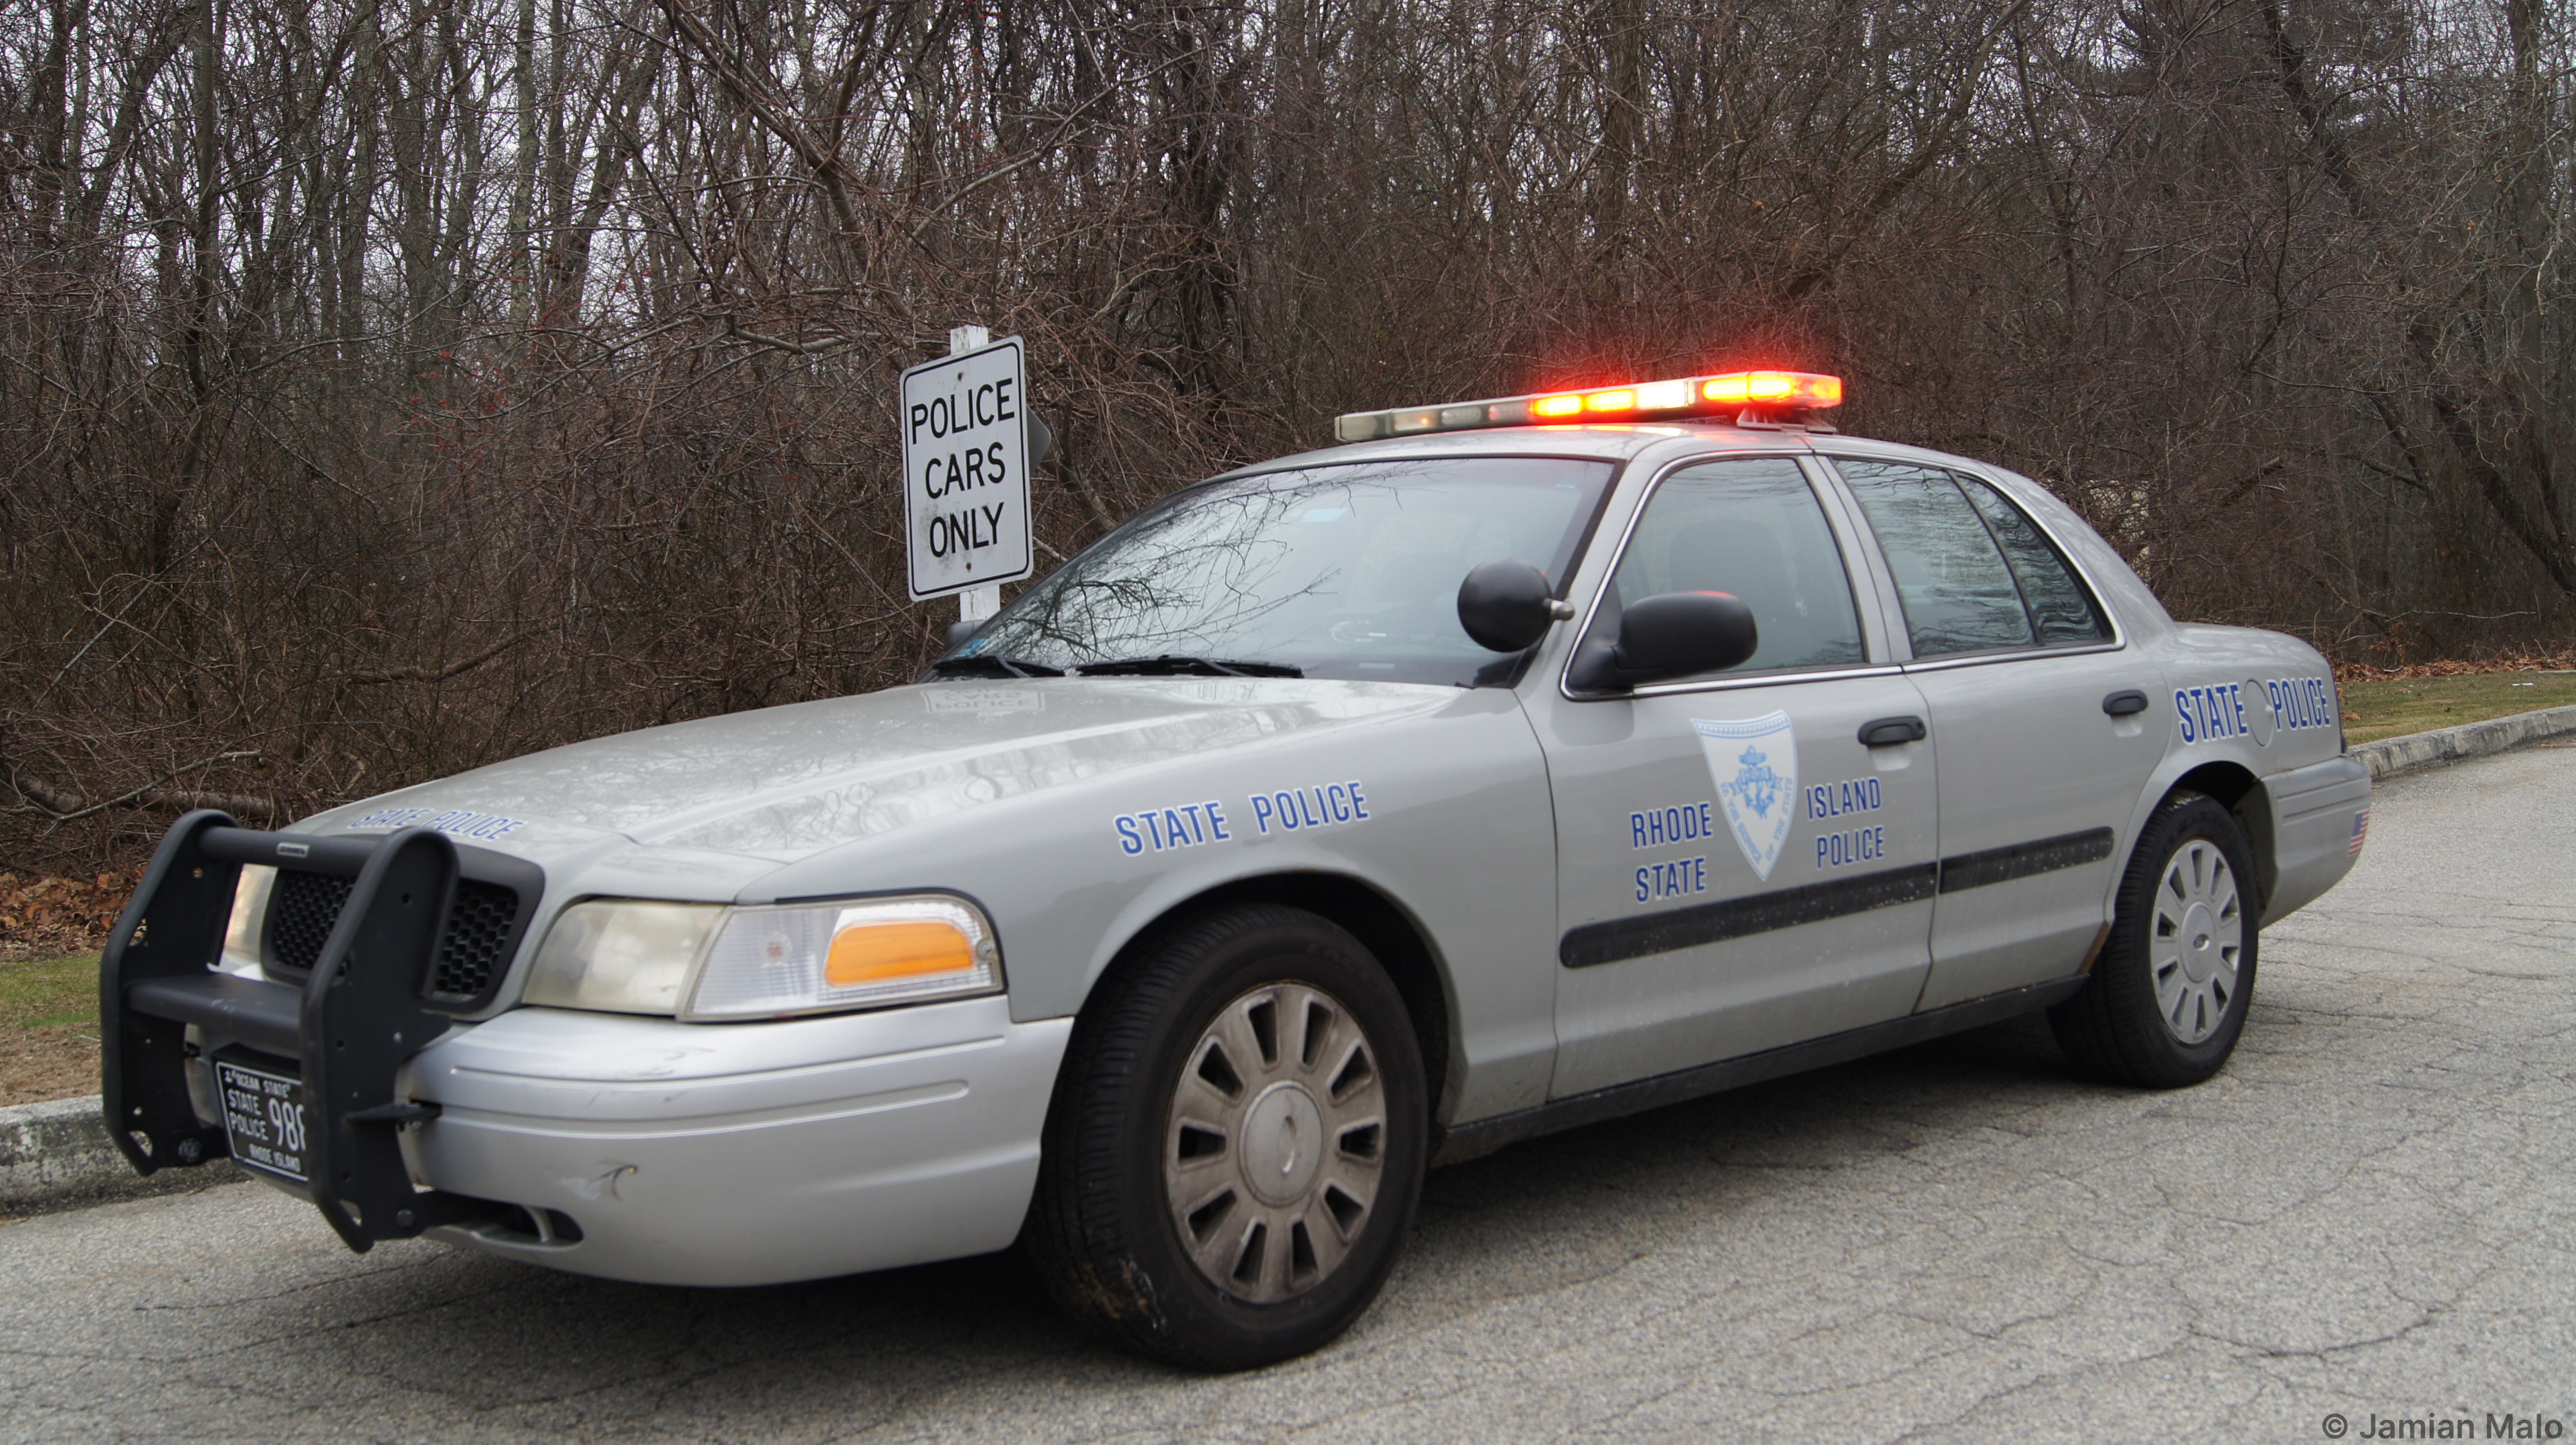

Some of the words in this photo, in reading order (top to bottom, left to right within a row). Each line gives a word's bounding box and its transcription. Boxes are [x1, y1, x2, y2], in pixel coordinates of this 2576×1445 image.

[912, 378, 1014, 444] POLICE
[925, 441, 1005, 499] CARS
[930, 502, 1004, 557] ONLY
[2175, 684, 2247, 744] STATE
[2267, 678, 2330, 731] POLICE
[349, 808, 432, 829] STATE
[422, 811, 526, 841] POLICE
[1115, 802, 1230, 855] STATE
[1250, 781, 1369, 834] POLICE
[1630, 802, 1713, 849] RHODE
[1805, 777, 1882, 820] ISLAND
[1636, 857, 1706, 903] STATE
[1817, 827, 1884, 869] POLICE
[227, 1089, 262, 1116] STATE
[229, 1111, 269, 1141] POLICE
[249, 1143, 273, 1165] RHODE
[273, 1150, 301, 1173] ISLAND
